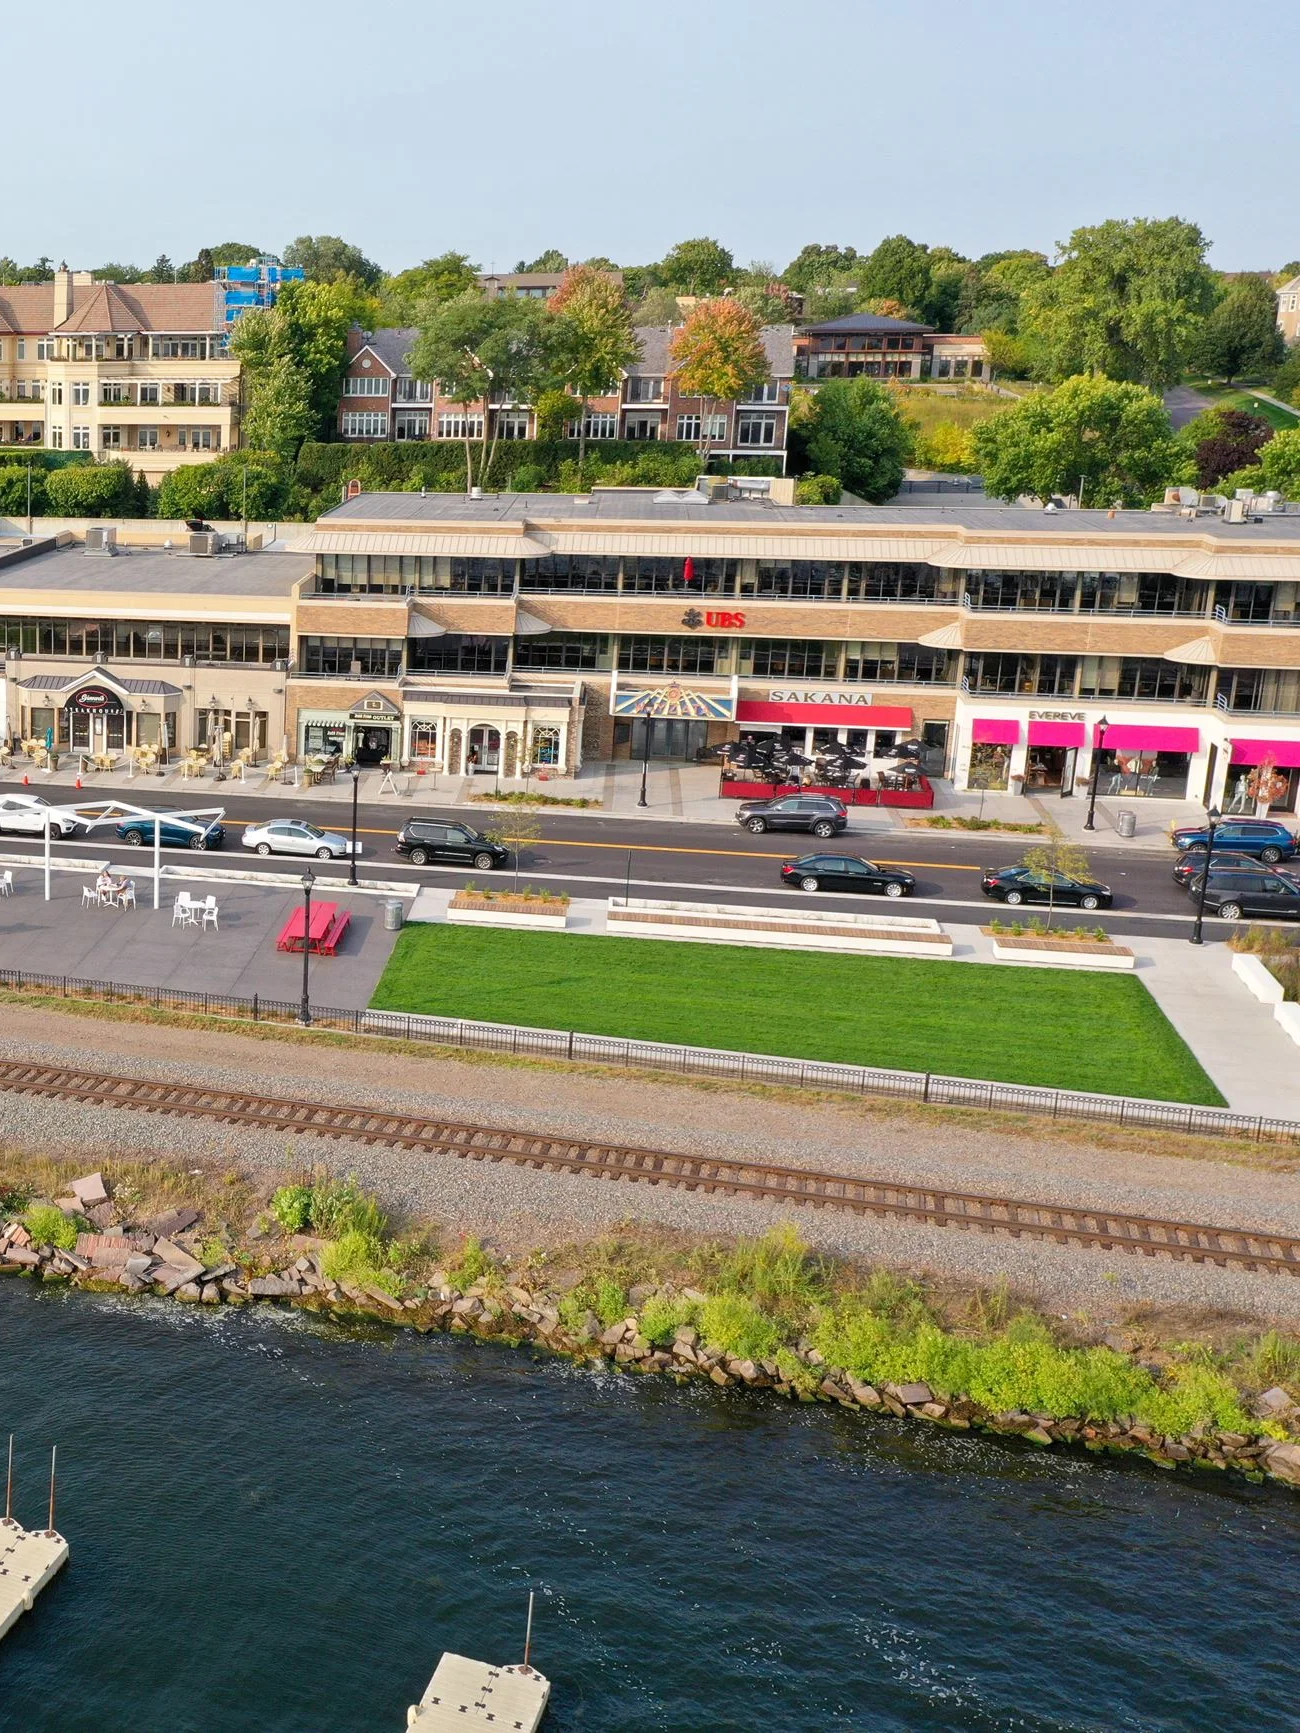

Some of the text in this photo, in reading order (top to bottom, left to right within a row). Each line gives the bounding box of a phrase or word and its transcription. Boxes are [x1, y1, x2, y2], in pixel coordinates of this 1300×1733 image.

[706, 611, 746, 629] UBS
[771, 690, 869, 705] SAKANA
[1028, 710, 1087, 721] EVEREVE
